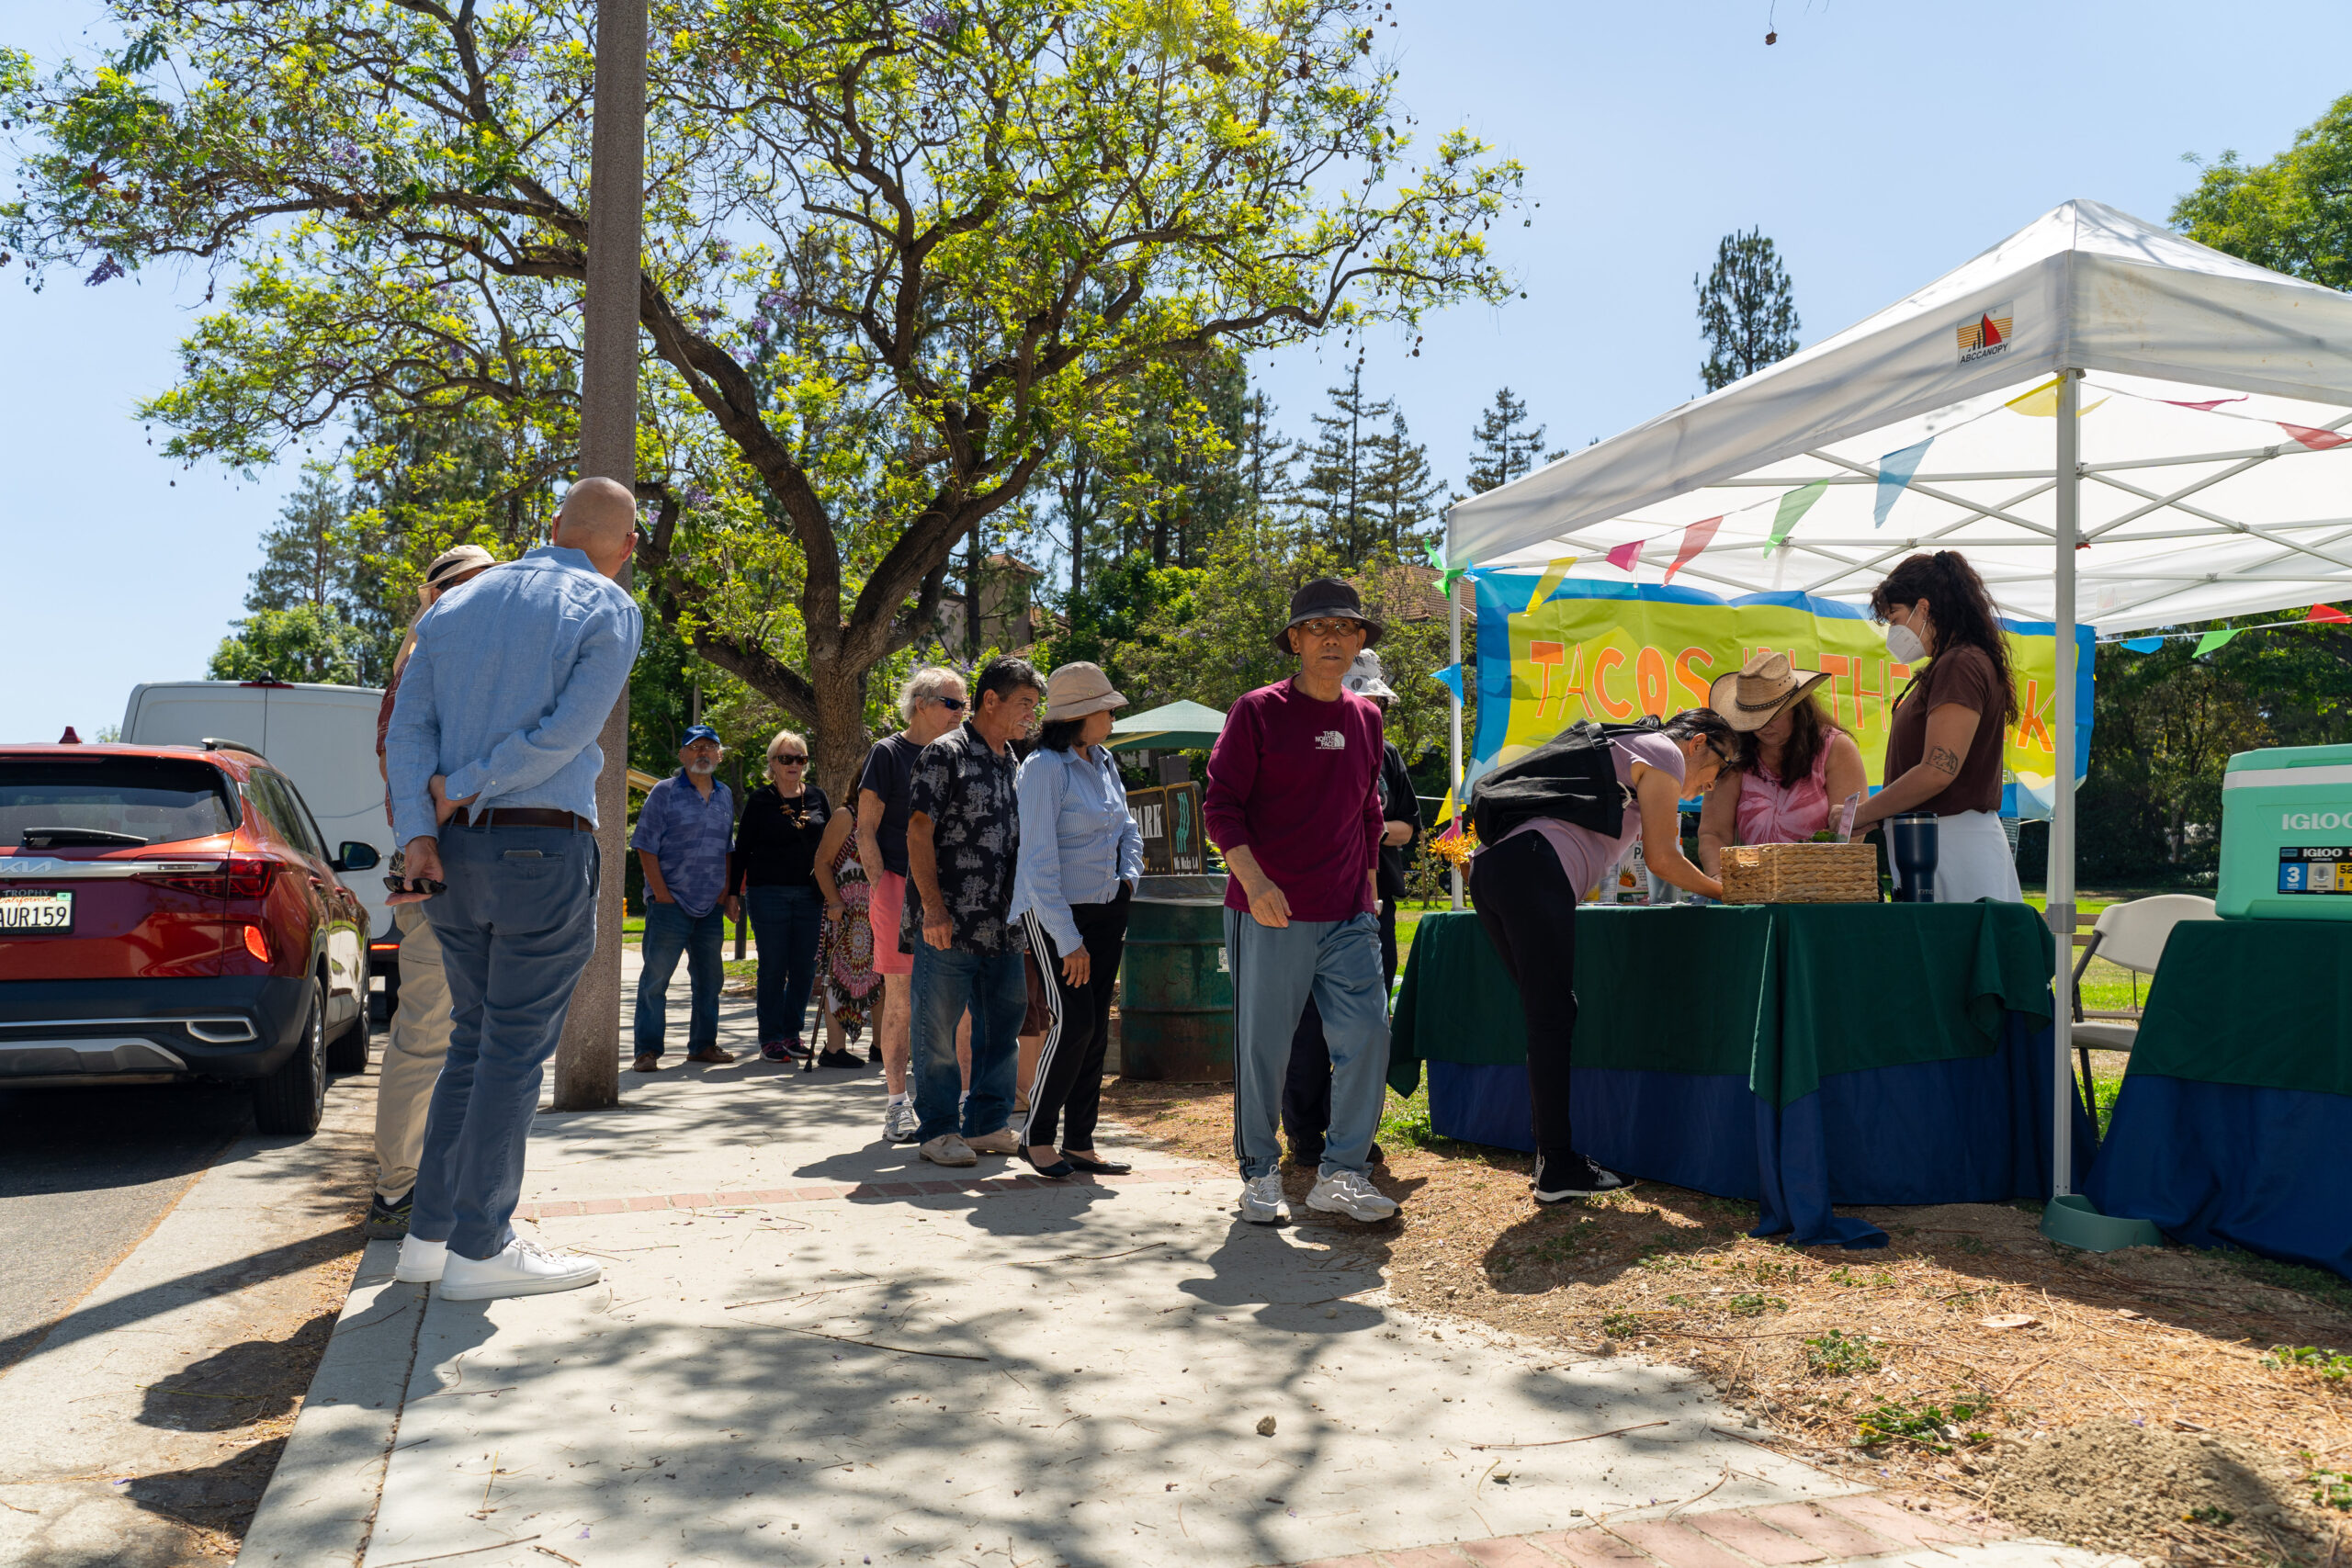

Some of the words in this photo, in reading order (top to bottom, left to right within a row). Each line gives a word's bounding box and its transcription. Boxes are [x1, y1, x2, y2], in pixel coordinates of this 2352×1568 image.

[1960, 343, 2008, 364] ABCCANOPY
[1530, 640, 1714, 720] TACOS
[2302, 848, 2343, 857] IGLOO
[2286, 866, 2301, 883] 3
